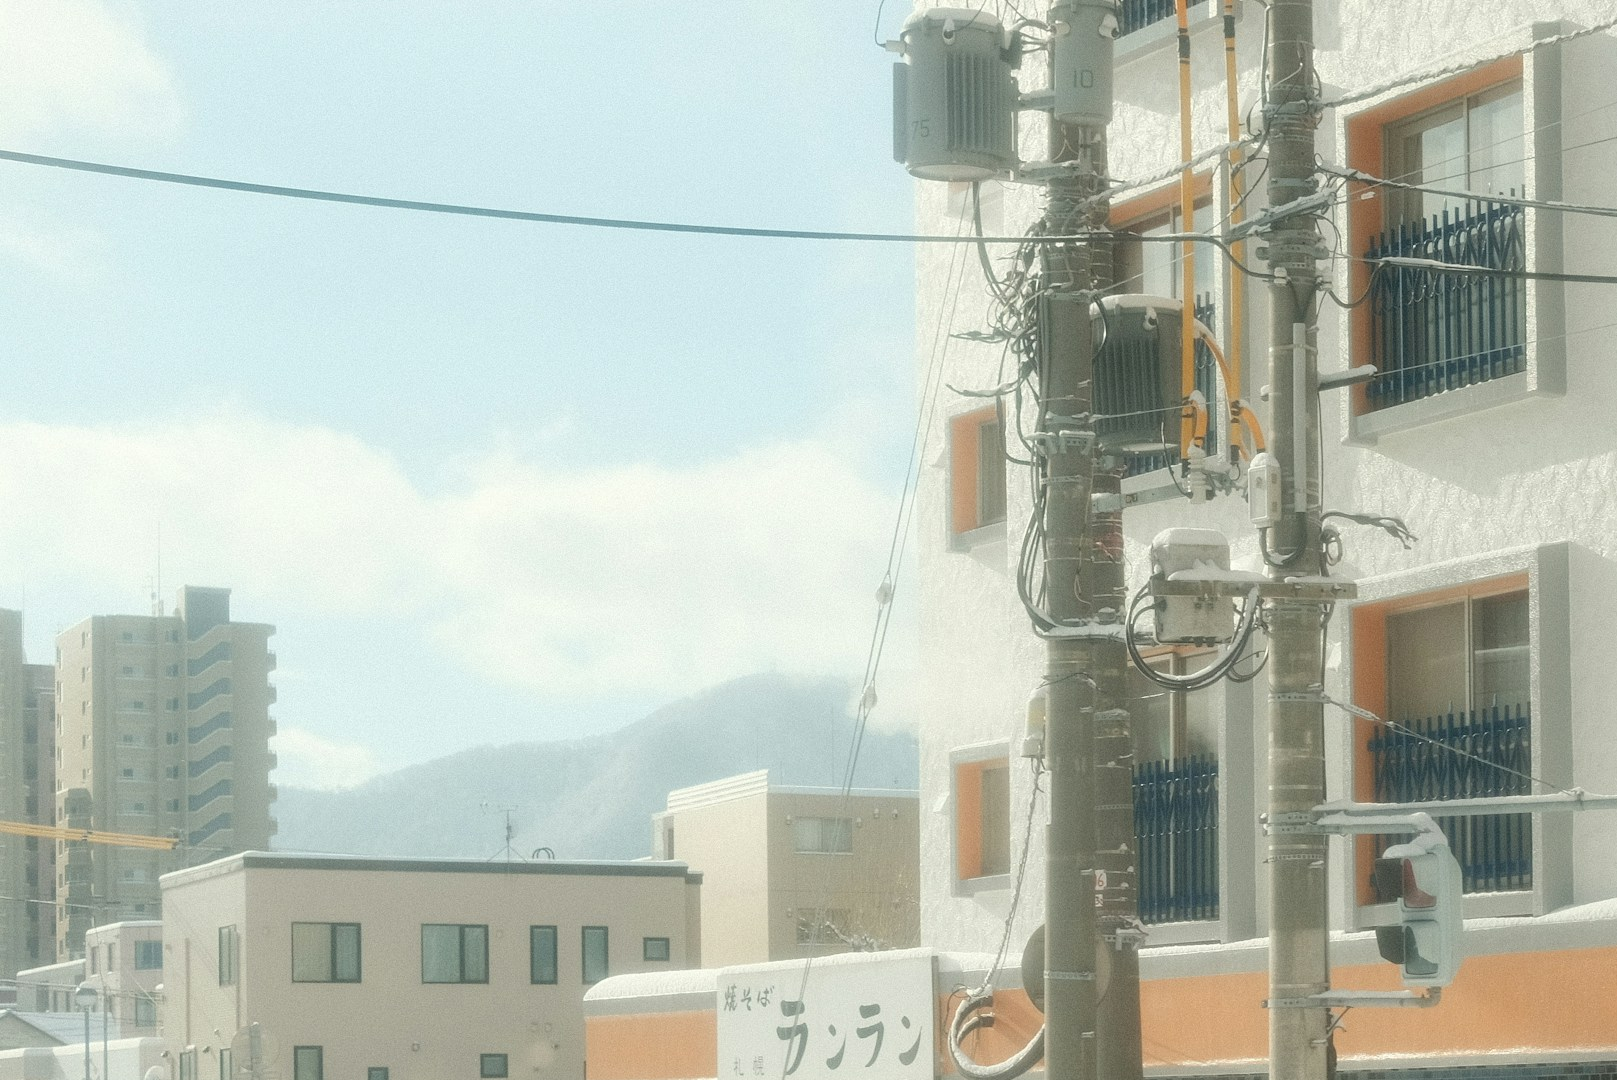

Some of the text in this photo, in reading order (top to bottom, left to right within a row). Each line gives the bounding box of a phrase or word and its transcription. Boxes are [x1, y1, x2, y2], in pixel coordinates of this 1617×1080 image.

[1073, 68, 1094, 89] 10
[723, 983, 775, 1012] 焼そば
[776, 1000, 923, 1076] ランラン
